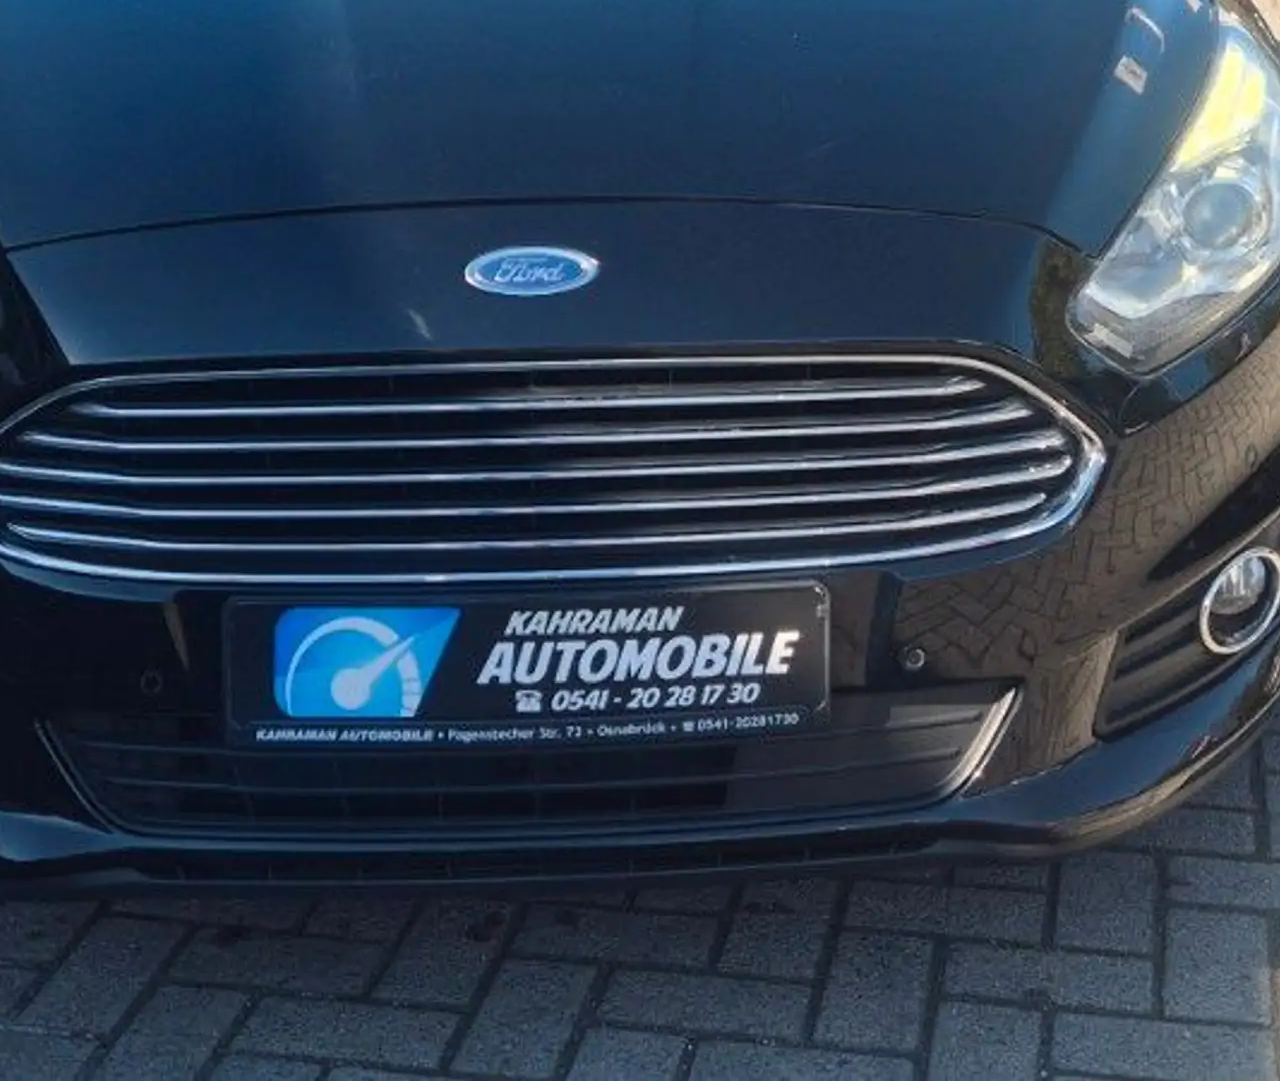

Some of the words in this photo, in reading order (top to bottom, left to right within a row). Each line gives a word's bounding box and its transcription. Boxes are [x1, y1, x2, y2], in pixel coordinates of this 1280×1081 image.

[494, 257, 566, 283] Ford
[504, 606, 685, 636] KAHRAMAN
[476, 630, 801, 684] AUTOMOBILE
[551, 690, 609, 712] 0541
[627, 687, 661, 709] 20
[664, 686, 696, 707] 28
[700, 684, 725, 706] 17
[727, 683, 761, 704] 30
[256, 727, 337, 742] KAHRAMAN
[339, 727, 434, 742] AUTOMOBILE
[539, 726, 562, 740] Str.
